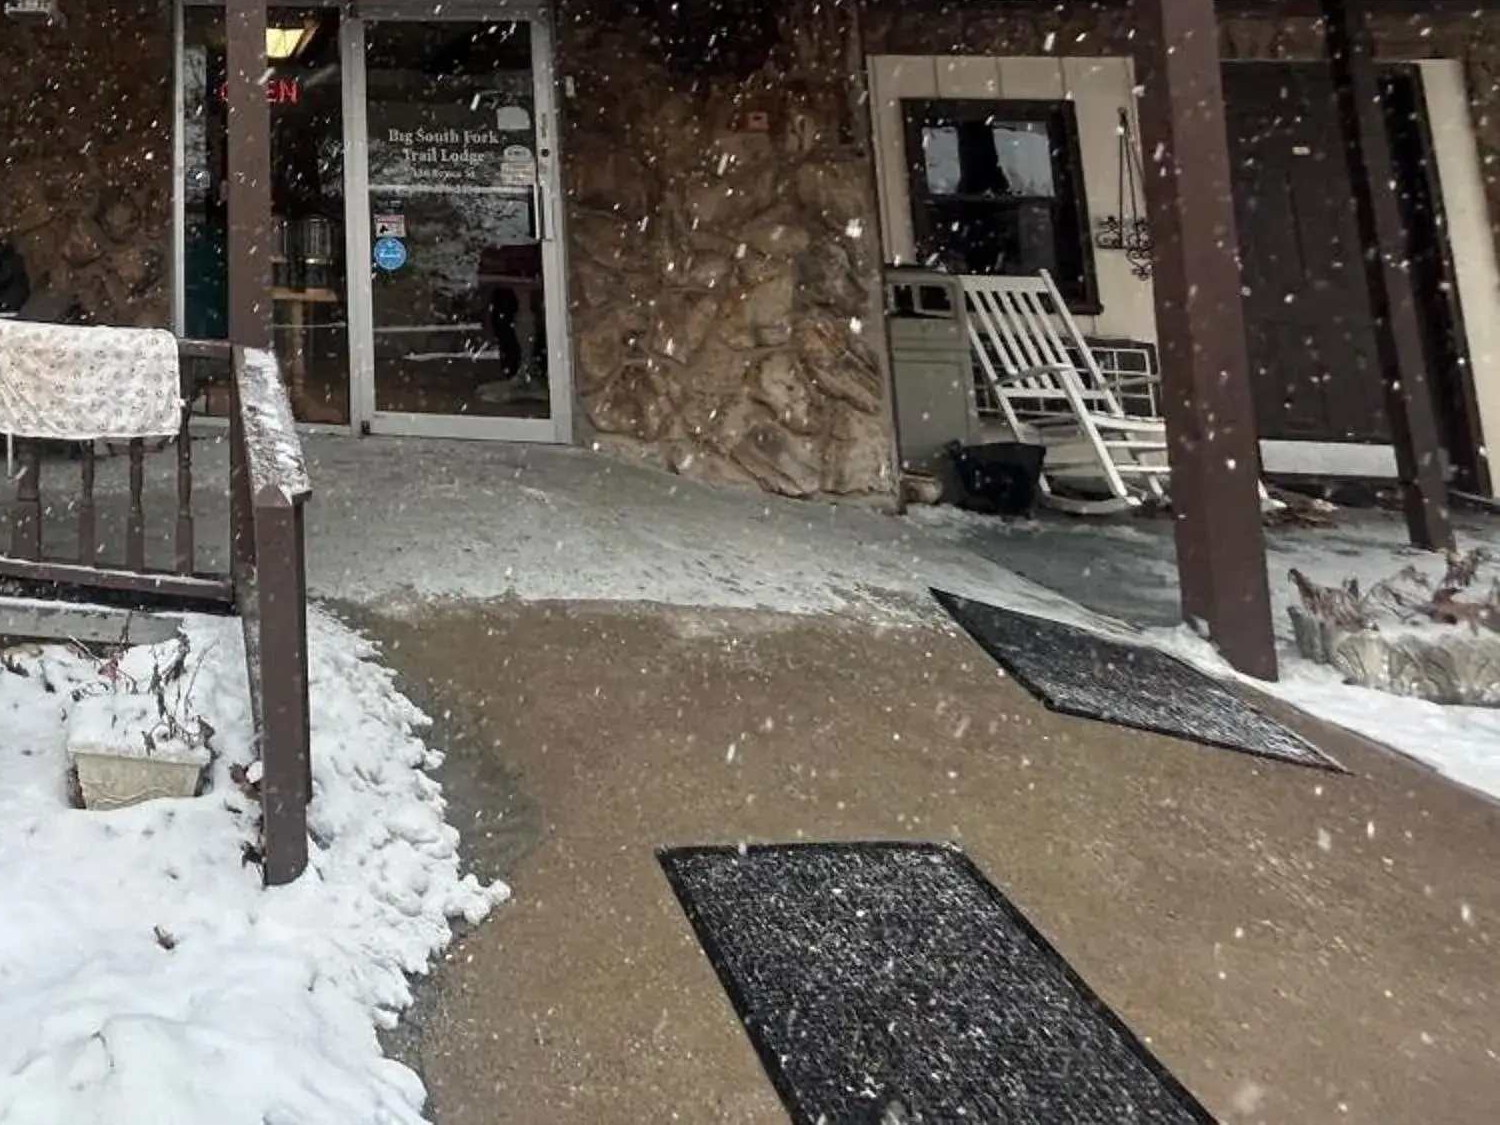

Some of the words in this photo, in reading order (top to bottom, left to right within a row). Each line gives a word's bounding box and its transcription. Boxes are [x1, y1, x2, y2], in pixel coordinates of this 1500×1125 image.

[388, 128, 413, 146] Big
[415, 127, 460, 144] South
[463, 129, 500, 147] Fork
[402, 147, 438, 163] Trail
[440, 147, 486, 165] Lodge
